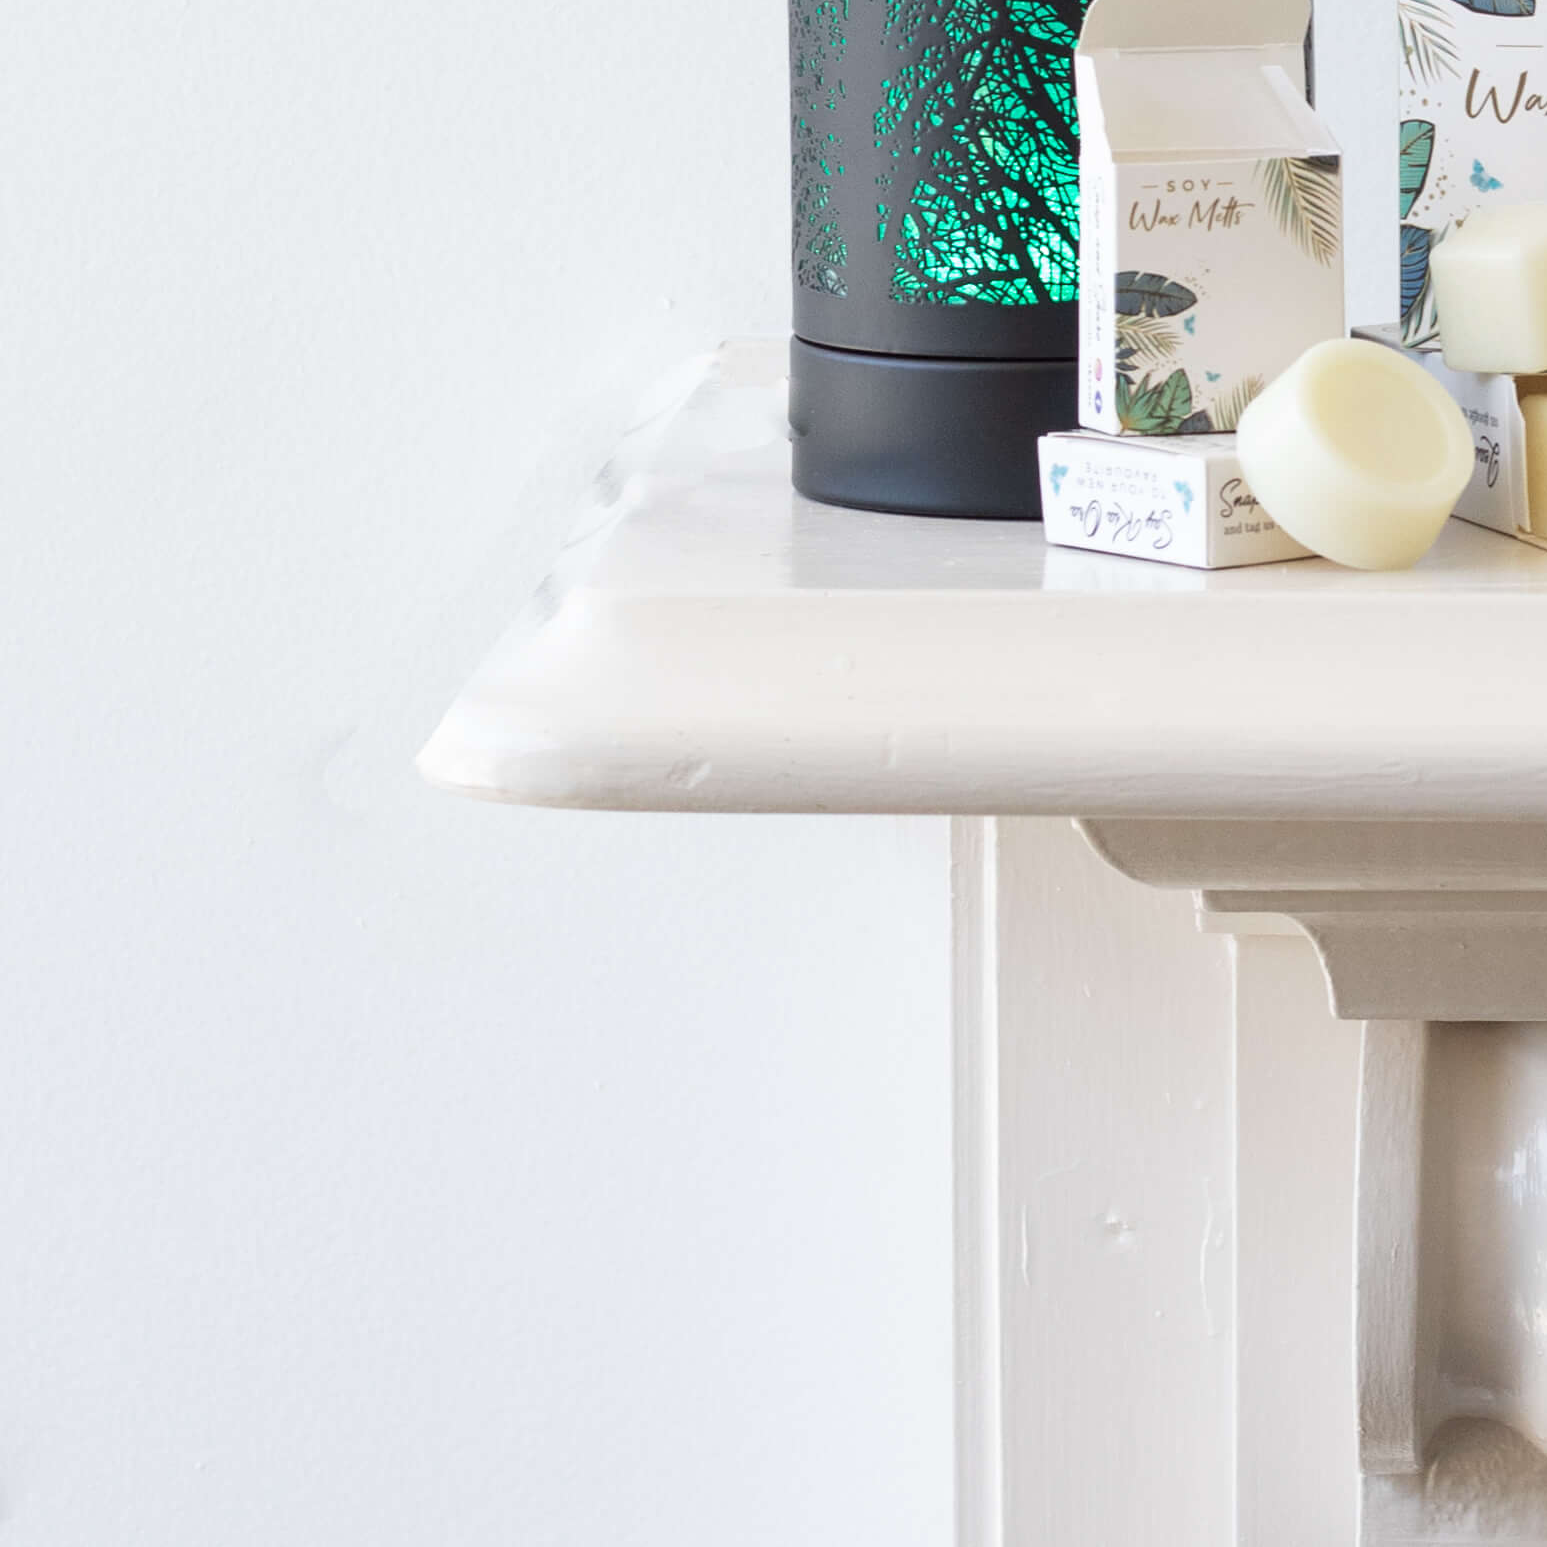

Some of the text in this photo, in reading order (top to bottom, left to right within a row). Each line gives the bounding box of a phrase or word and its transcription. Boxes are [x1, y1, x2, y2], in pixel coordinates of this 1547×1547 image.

[1166, 179, 1211, 193] SOY
[1128, 196, 1255, 232] Wax Melts
